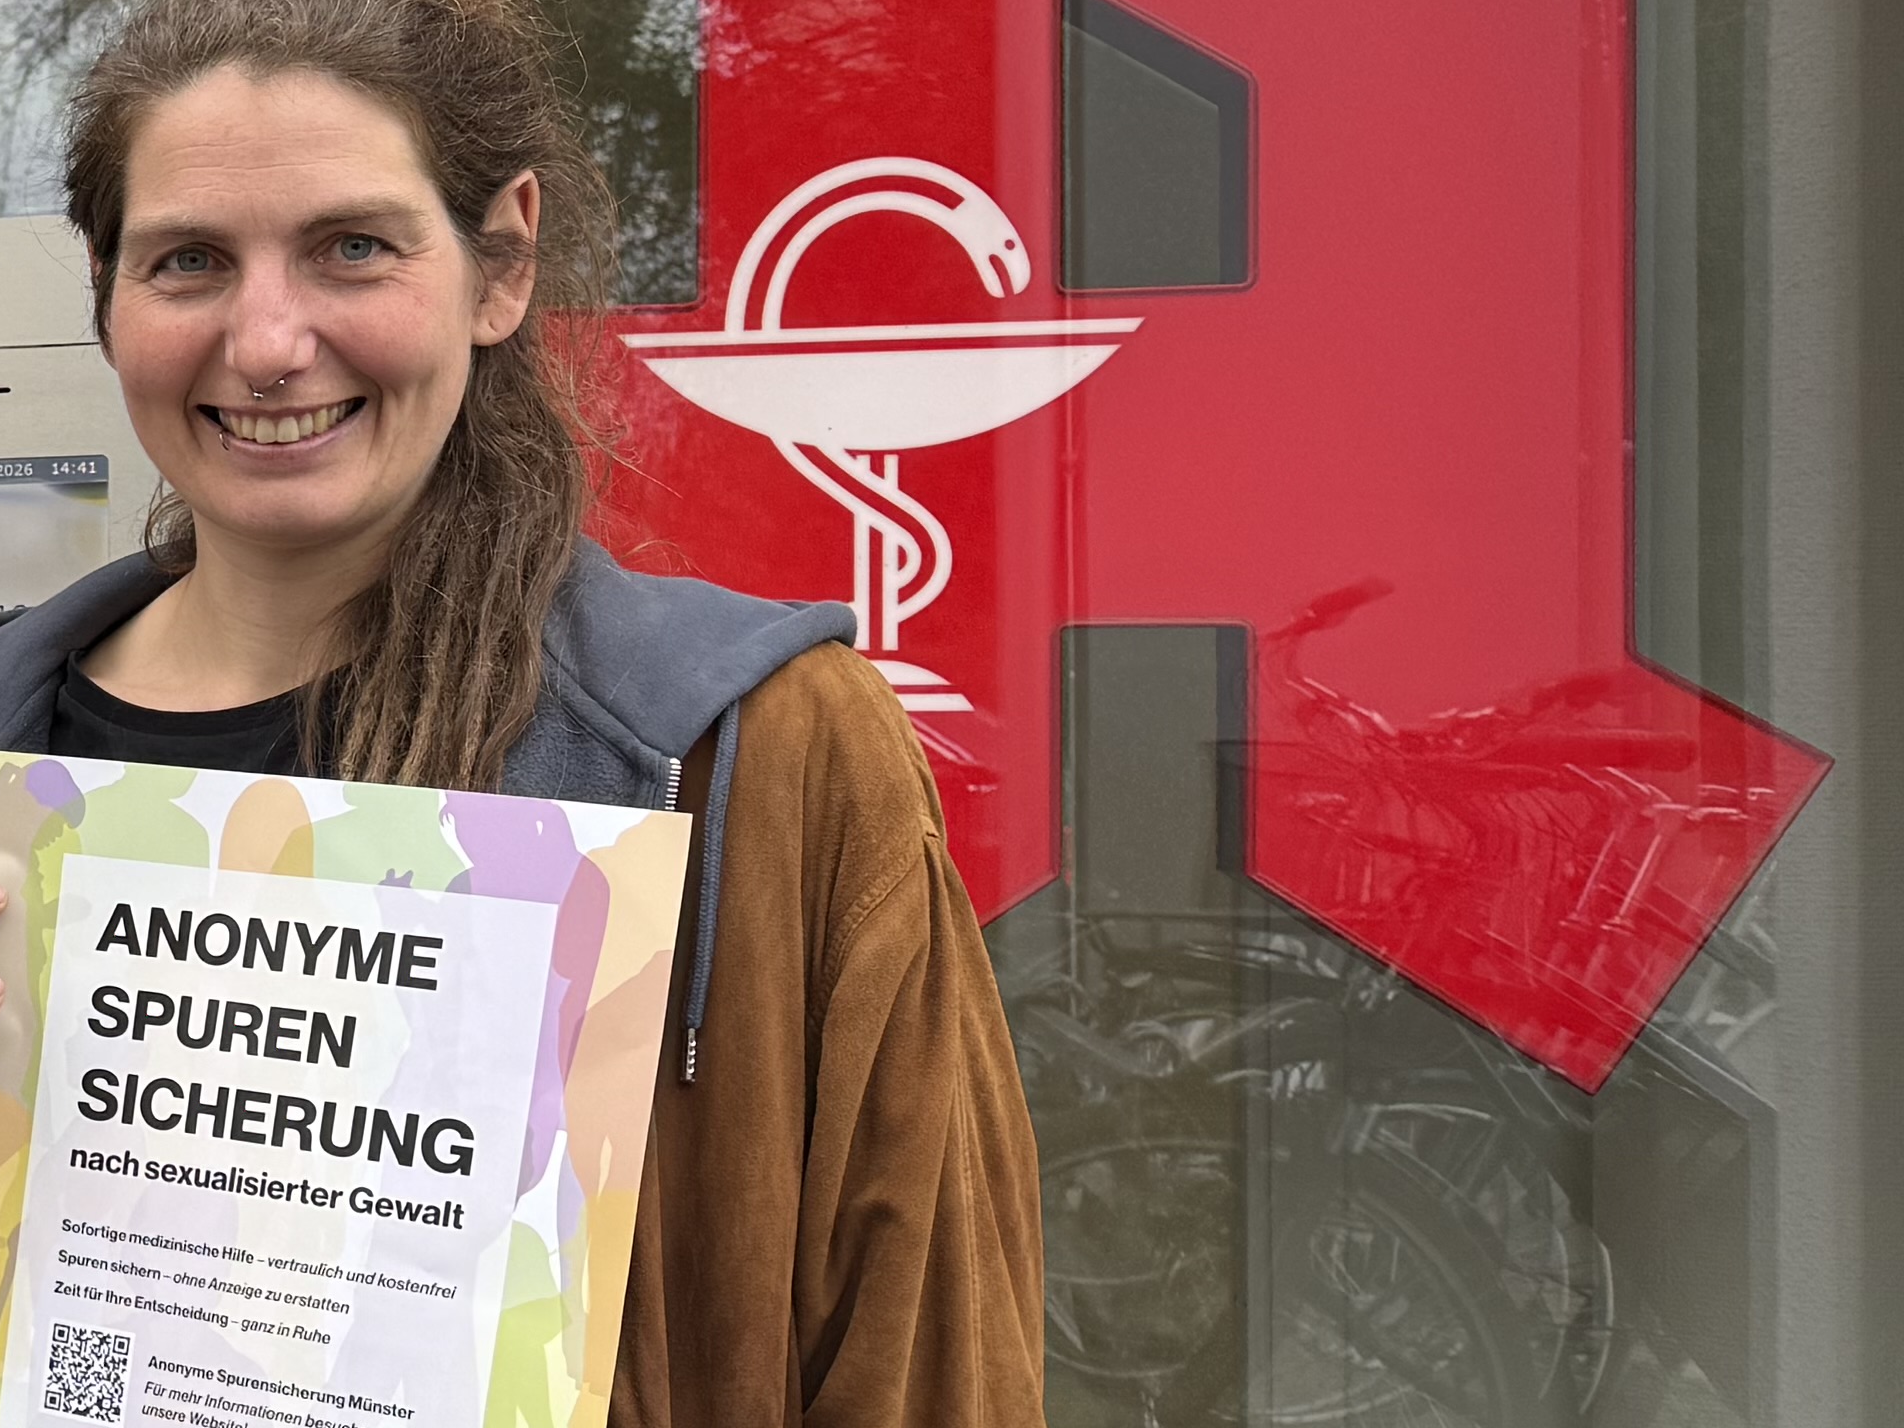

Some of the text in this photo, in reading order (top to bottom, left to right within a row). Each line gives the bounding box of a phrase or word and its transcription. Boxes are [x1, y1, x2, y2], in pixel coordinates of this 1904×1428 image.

[51, 461, 97, 476] 14:41
[95, 902, 444, 991] ANONYME
[87, 985, 357, 1069] SPUREN
[77, 1068, 475, 1177] SICHERUNG
[70, 1148, 465, 1230] nach sexualisierter Gewalt
[58, 1249, 108, 1271] Spuren
[110, 1260, 161, 1280] sichern
[172, 1272, 206, 1289] ohne
[207, 1277, 263, 1300] Anzeige
[264, 1290, 282, 1302] zu
[283, 1293, 350, 1315] erstatten
[61, 1218, 127, 1243] Sofortige
[128, 1233, 220, 1258] medizinische
[222, 1246, 254, 1265] Hilfe
[268, 1257, 344, 1280] vertraulich
[346, 1271, 377, 1285] und
[376, 1273, 457, 1300] kostenfrei
[53, 1280, 81, 1298] Zeit
[83, 1286, 104, 1301] für
[105, 1289, 132, 1307] Ihre
[134, 1295, 229, 1328] Entscheidung
[241, 1319, 276, 1335] ganz
[276, 1322, 290, 1337] in
[292, 1325, 331, 1345] Ruhe
[141, 1404, 186, 1423] unsere
[144, 1380, 167, 1397] Für
[168, 1389, 203, 1405] mehr
[204, 1394, 302, 1426] Informationen
[147, 1355, 416, 1420] Anonyme Spurensicherung Münster
